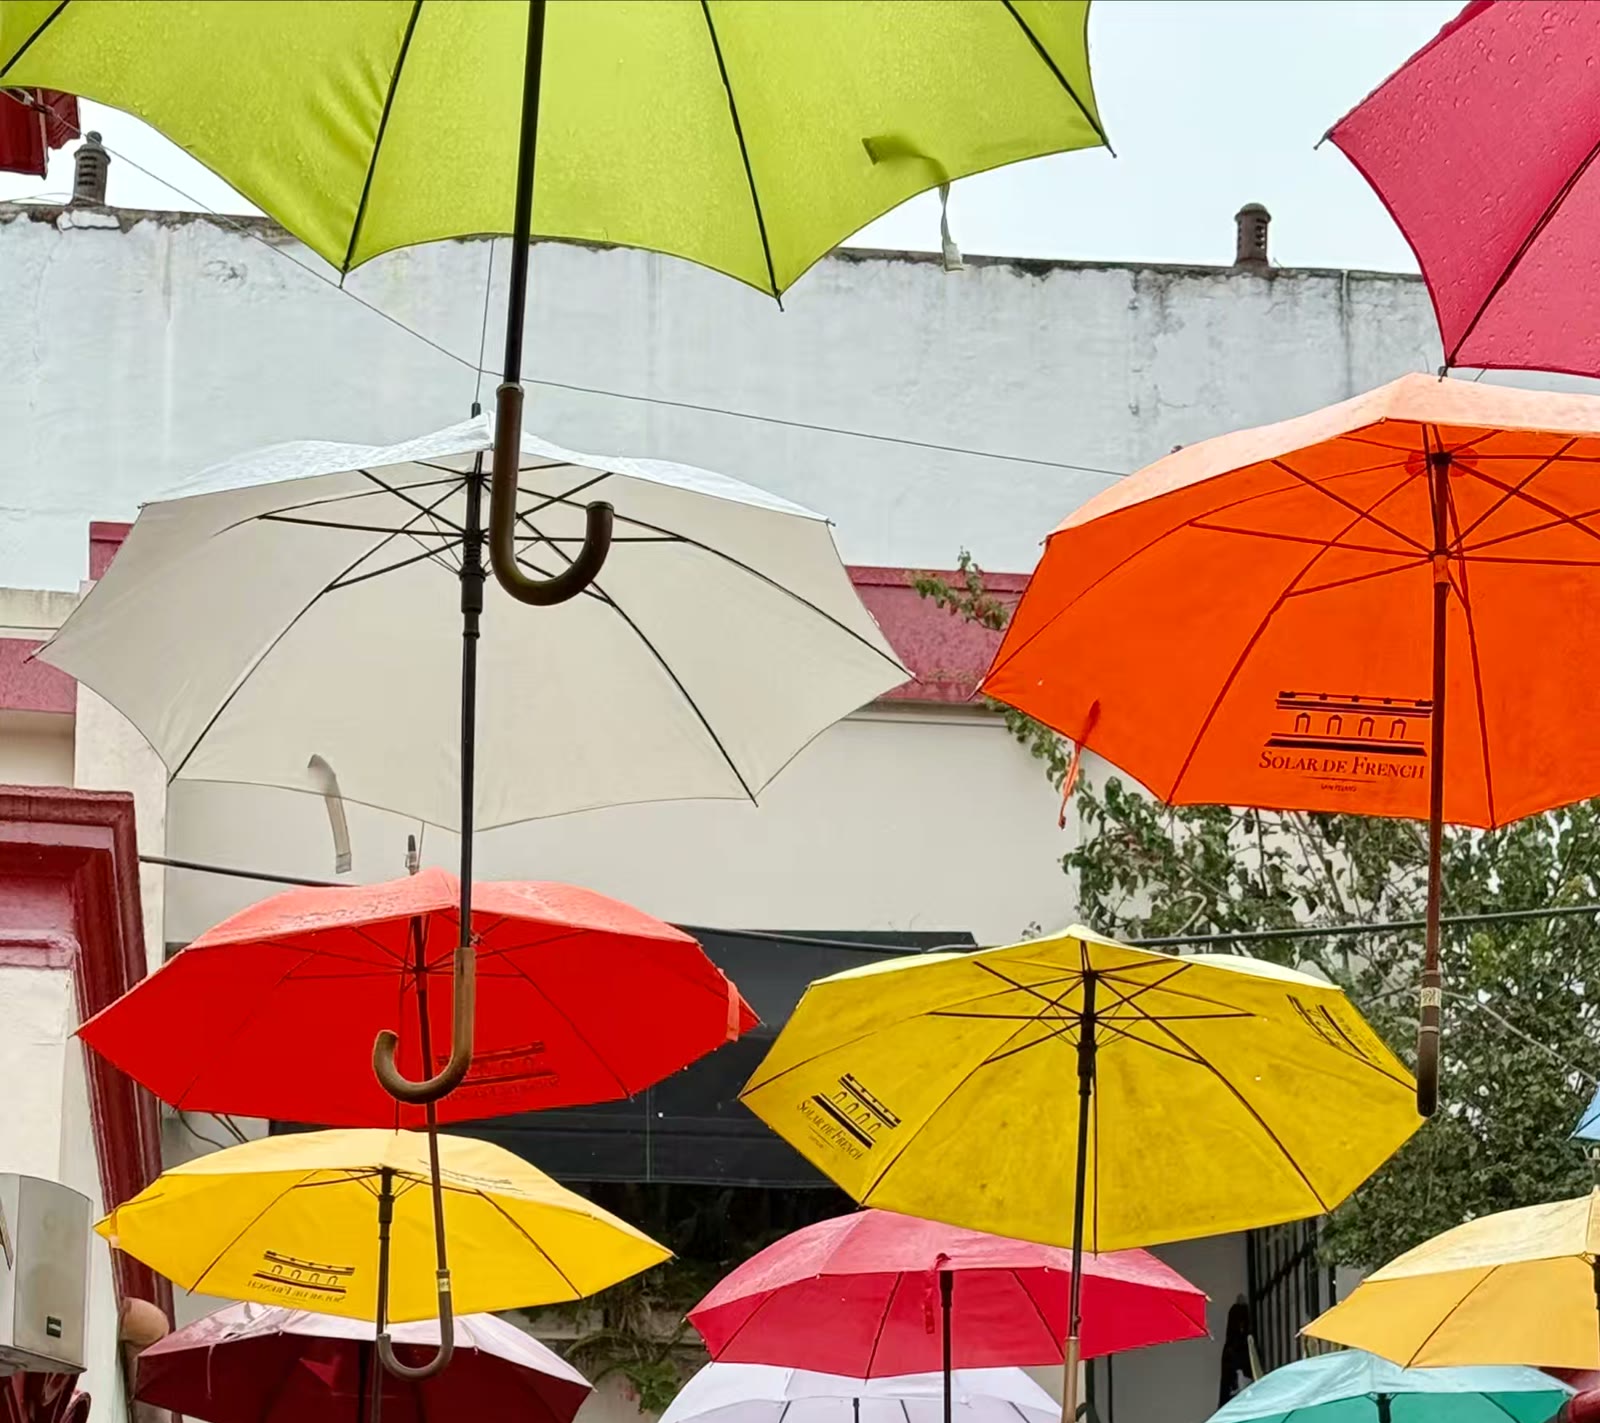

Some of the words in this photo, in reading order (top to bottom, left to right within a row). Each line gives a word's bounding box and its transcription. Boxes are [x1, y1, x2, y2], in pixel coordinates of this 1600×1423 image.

[1259, 750, 1318, 773] SOLAR
[1321, 759, 1347, 773] DE
[1352, 757, 1425, 779] FRENCH
